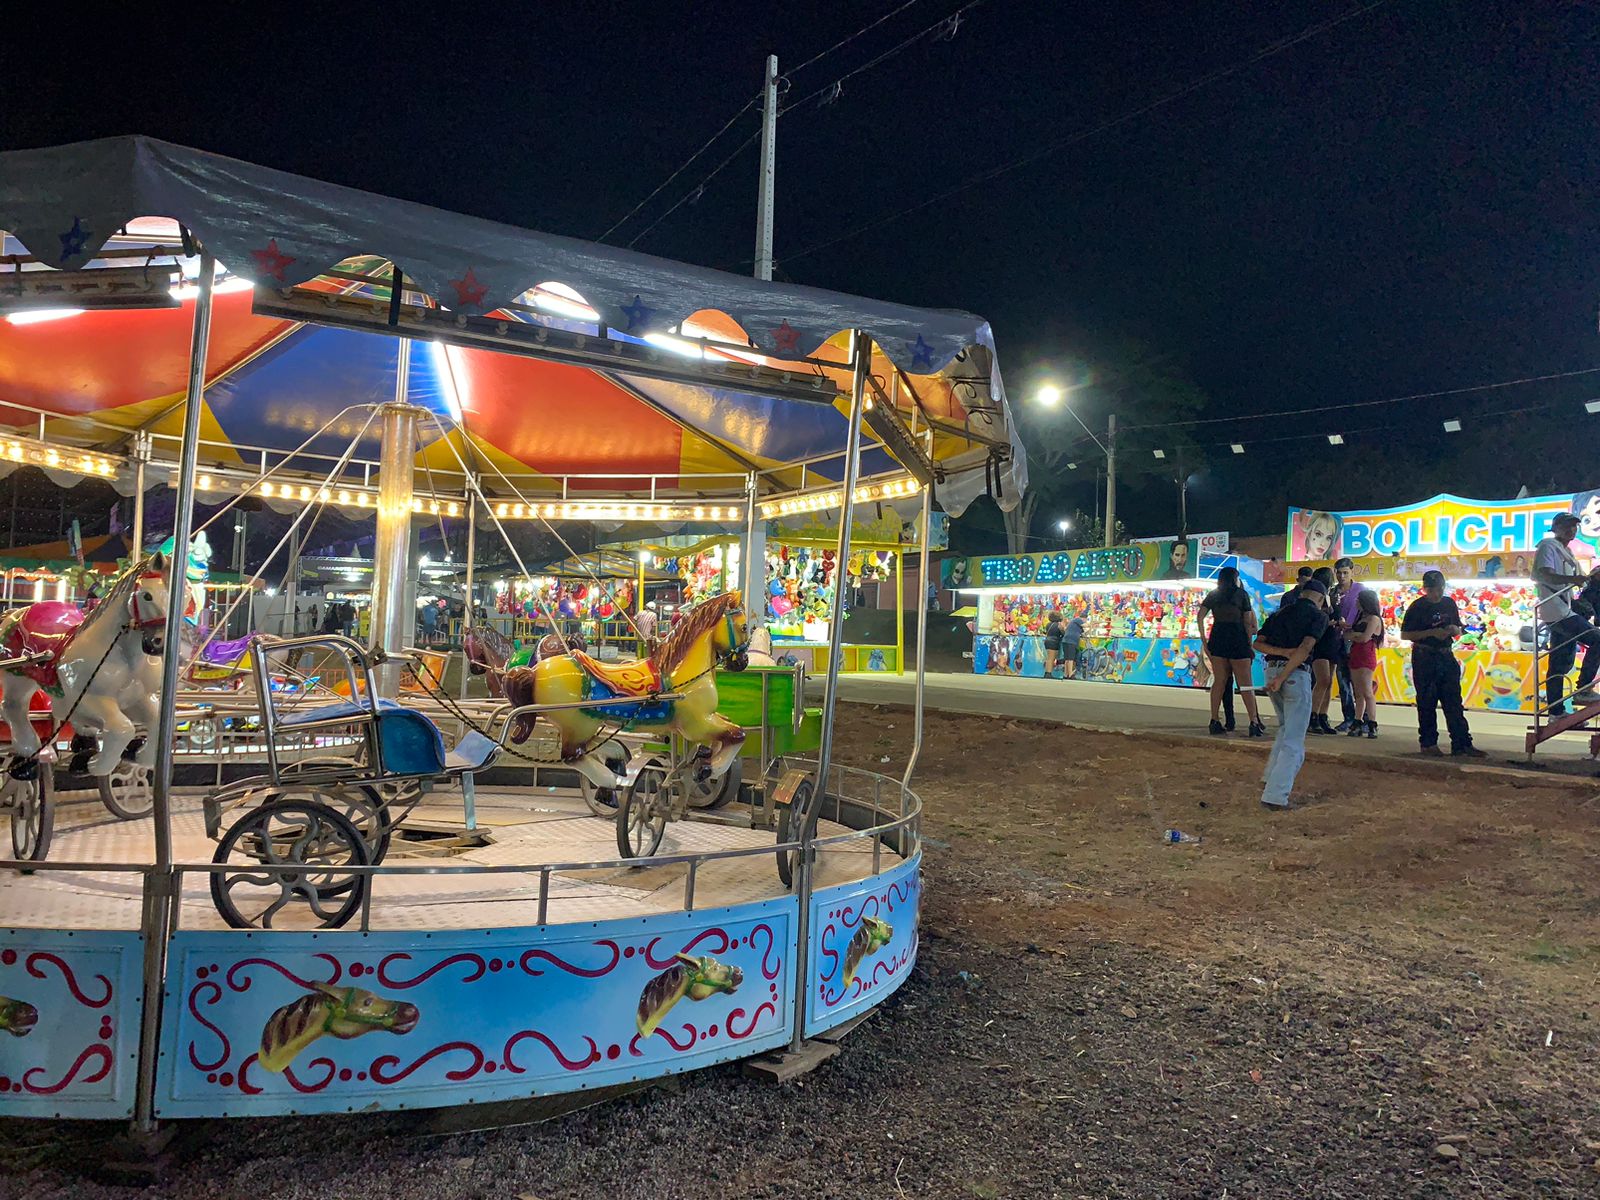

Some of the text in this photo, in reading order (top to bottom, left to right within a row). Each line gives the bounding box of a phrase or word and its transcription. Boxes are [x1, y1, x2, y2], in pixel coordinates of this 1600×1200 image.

[1341, 512, 1562, 557] BOLICHE
[981, 547, 1145, 586] TIRO AO ALVO
